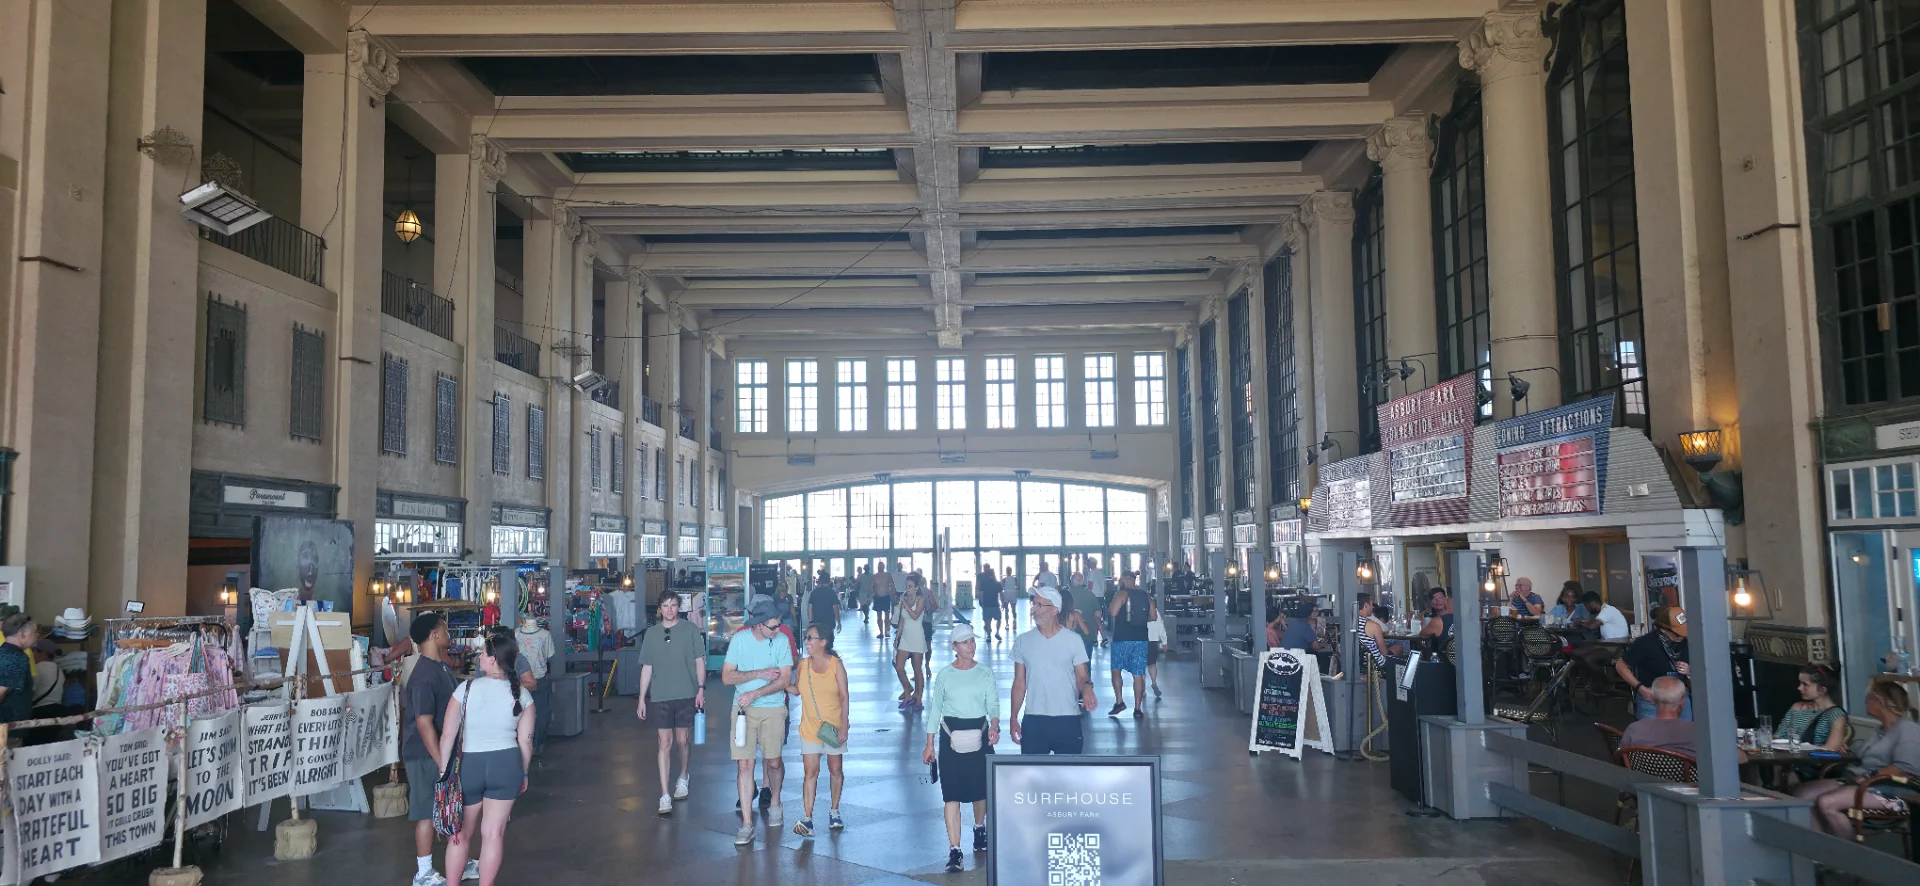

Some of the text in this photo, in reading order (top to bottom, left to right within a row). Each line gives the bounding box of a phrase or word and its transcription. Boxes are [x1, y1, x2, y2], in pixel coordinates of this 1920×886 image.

[1391, 384, 1457, 420] ASBURY PARK
[1441, 407, 1465, 428] HALL
[1496, 406, 1603, 443] COMING ATTRACTIONS
[249, 488, 286, 501] Paramount
[310, 708, 327, 717] BOB
[199, 731, 217, 743] JIM
[248, 723, 273, 737] WHAT
[297, 721, 327, 734] EVERY
[120, 742, 133, 753] TOM
[248, 733, 292, 756] STRANG
[296, 731, 341, 753] THING
[27, 755, 52, 767] DOLLY
[105, 749, 161, 773] YOU'VE GOT
[187, 746, 217, 770] LET'S
[249, 749, 292, 777] TRIP
[296, 757, 305, 766] IS
[17, 764, 84, 792] START EACH
[109, 767, 155, 791] A HEART
[196, 762, 231, 786] TO THE
[249, 769, 290, 796] IT'S BEEN
[295, 761, 339, 786] ALRIGHT
[19, 788, 82, 817] DAY WITH A
[106, 784, 157, 817] SO BIG
[185, 778, 234, 817] MOON
[1014, 791, 1133, 805] SURFHOUSE
[132, 806, 155, 822] CRUSH
[105, 820, 156, 849] THIS TOWN
[22, 837, 81, 870] HEART
